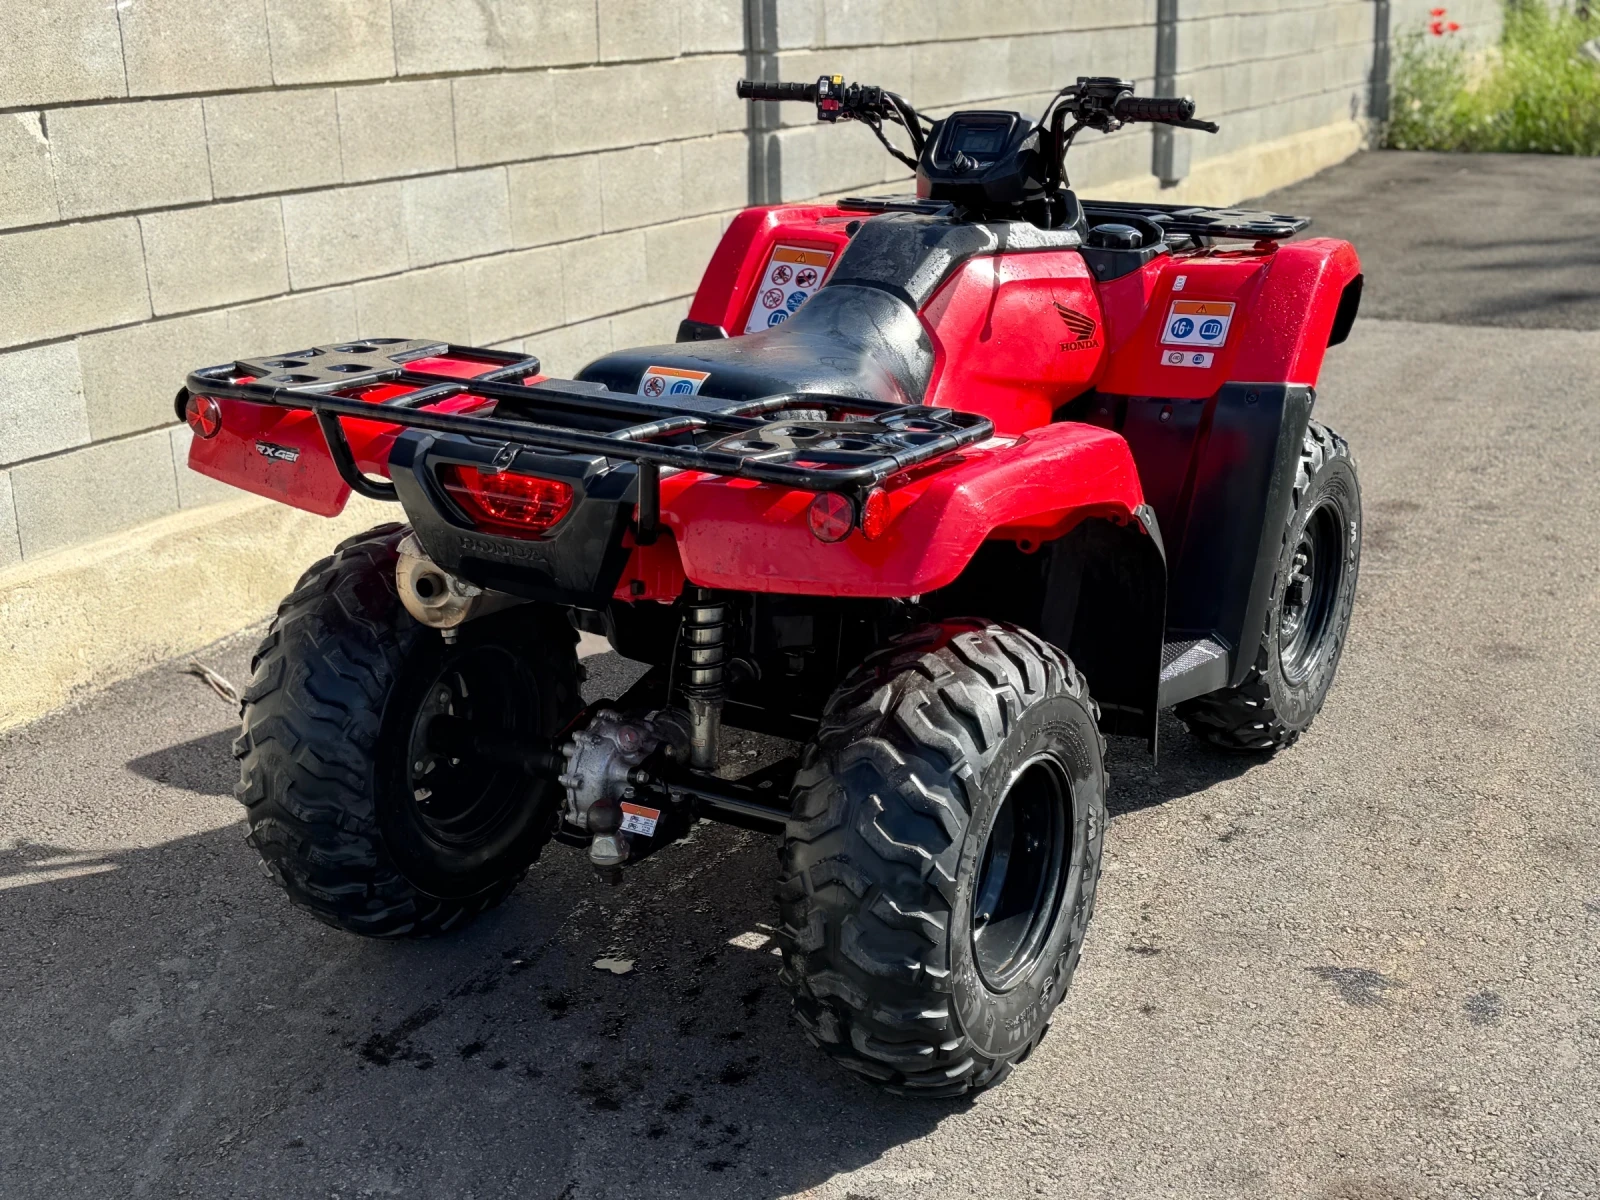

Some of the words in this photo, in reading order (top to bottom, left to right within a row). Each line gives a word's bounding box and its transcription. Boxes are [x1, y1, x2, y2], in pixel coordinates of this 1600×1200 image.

[1173, 321, 1192, 335] 16+
[1061, 340, 1099, 352] HONDA
[458, 536, 546, 562] HONDA
